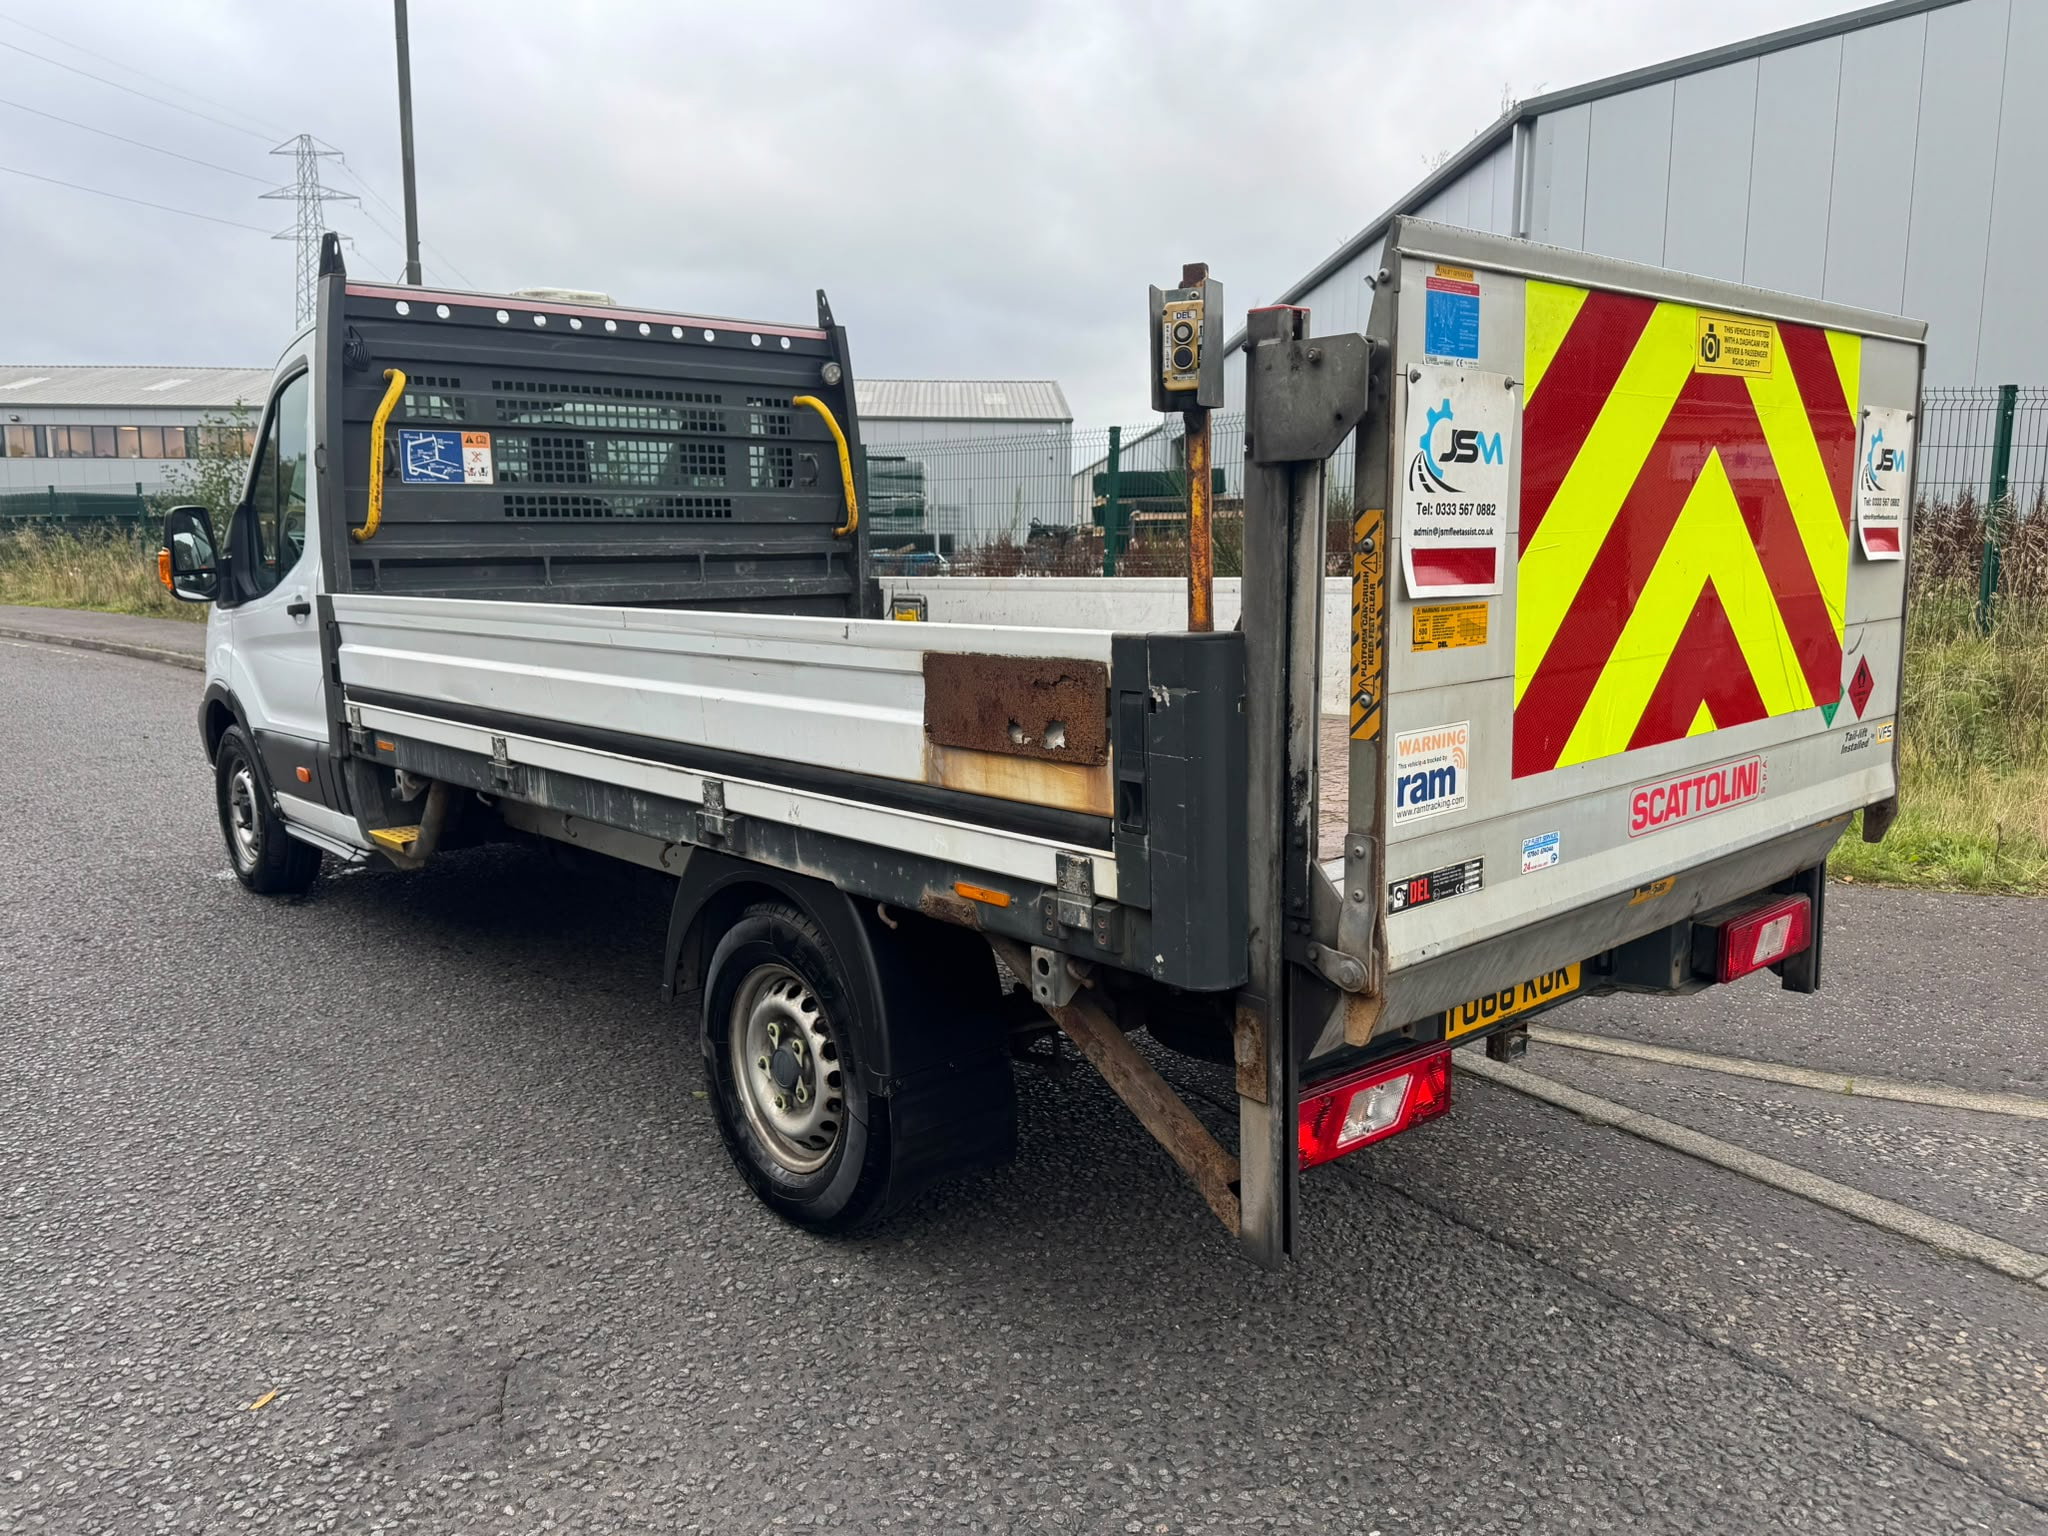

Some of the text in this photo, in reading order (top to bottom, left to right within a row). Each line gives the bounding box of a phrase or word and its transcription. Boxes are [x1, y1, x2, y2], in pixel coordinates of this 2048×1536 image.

[1176, 311, 1192, 319] DEL
[1438, 429, 1504, 465] JSM
[1875, 448, 1904, 472] JSM
[1416, 502, 1496, 516] Tel: 0333 567 0882
[1413, 527, 1494, 539] admin@jsmfleetassist.co.uk
[1398, 729, 1467, 756] WARNING
[1878, 725, 1892, 738] VFS
[1397, 765, 1456, 808] ram
[1632, 761, 1759, 831] SCATTOLINI
[1396, 796, 1465, 819] www.ramtracking.com
[1410, 877, 1430, 904] DEL
